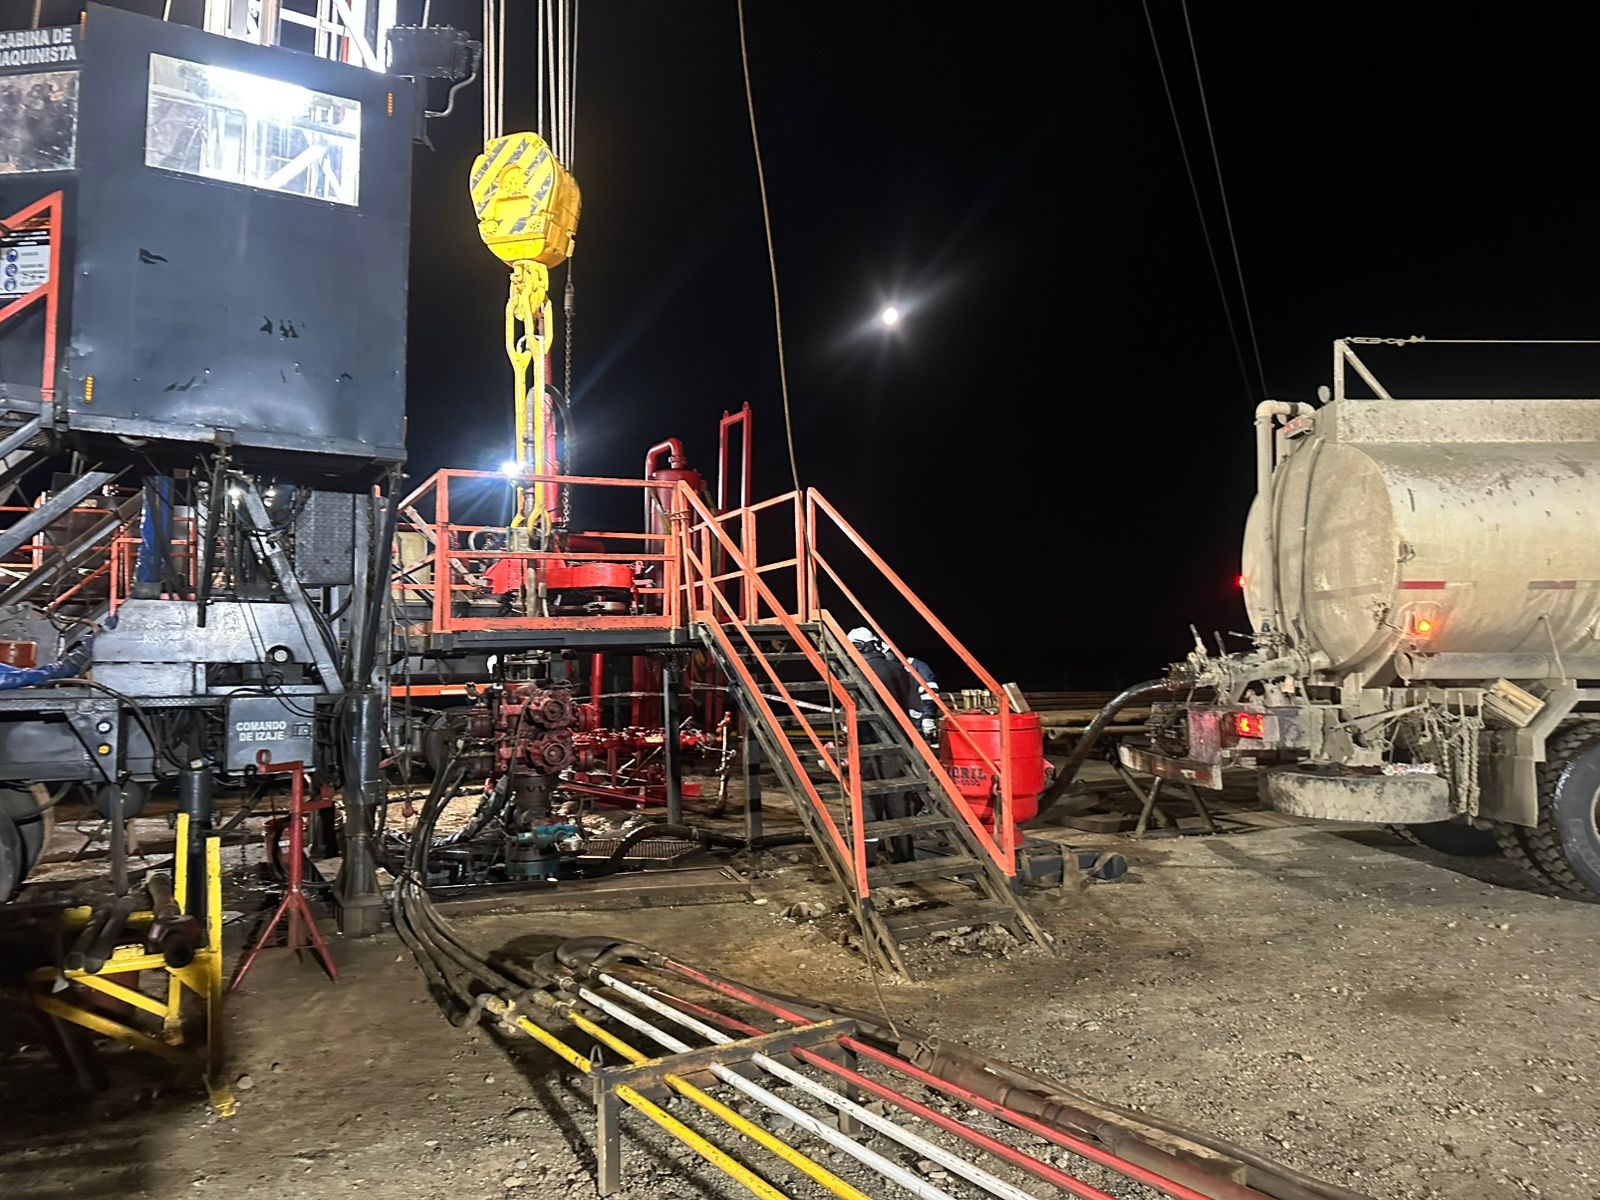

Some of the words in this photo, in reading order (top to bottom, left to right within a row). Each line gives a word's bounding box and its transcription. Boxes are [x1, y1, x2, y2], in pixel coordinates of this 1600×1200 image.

[0, 30, 50, 49] CABINA
[52, 27, 72, 44] DE
[235, 721, 287, 731] COMANDO
[239, 732, 254, 741] DE
[255, 731, 285, 741] IZAJE
